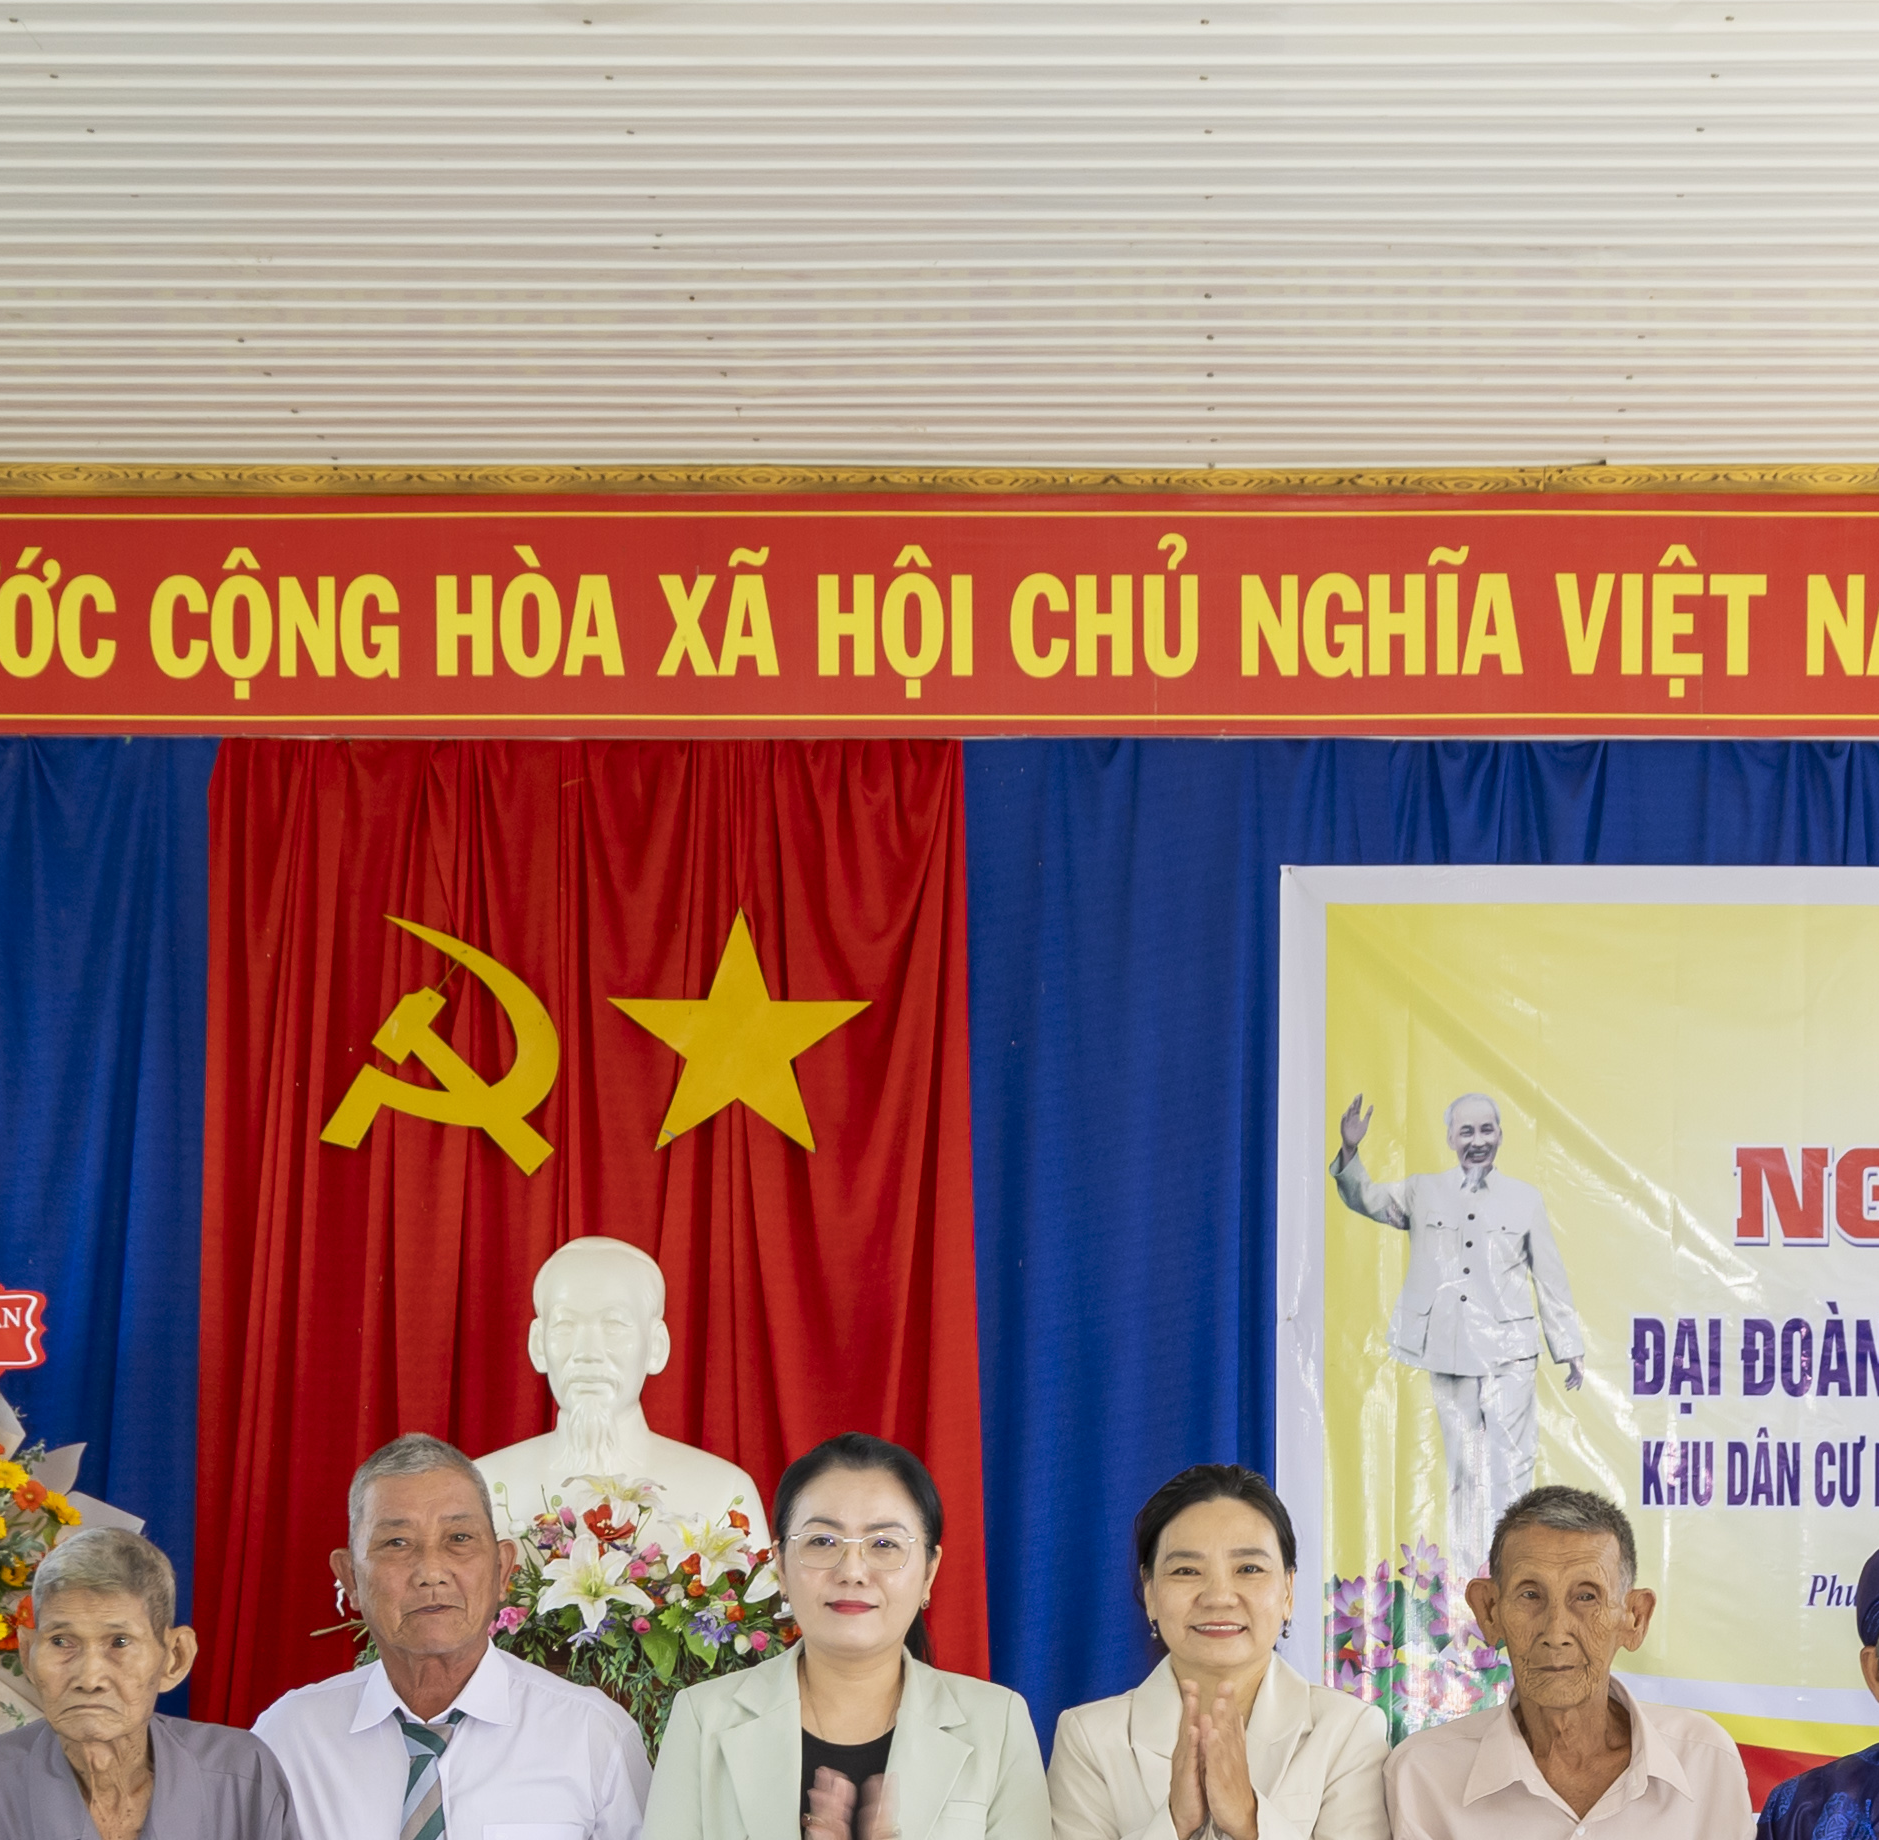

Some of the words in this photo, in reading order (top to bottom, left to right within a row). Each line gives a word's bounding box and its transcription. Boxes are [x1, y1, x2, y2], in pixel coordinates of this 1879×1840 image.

[150, 548, 399, 699] CỘNG
[437, 546, 624, 677] HÒA
[657, 547, 779, 675] XÃ
[818, 546, 972, 698] HỘI
[1010, 534, 1198, 677] CHỦ
[1242, 546, 1523, 677] NGHĨA
[1556, 545, 1766, 697] VIỆT
[1632, 1319, 1721, 1414] ĐẠI
[1643, 1442, 1713, 1506] KHU
[1728, 1428, 1800, 1506] DÂN
[1815, 1436, 1865, 1507] CƯ
